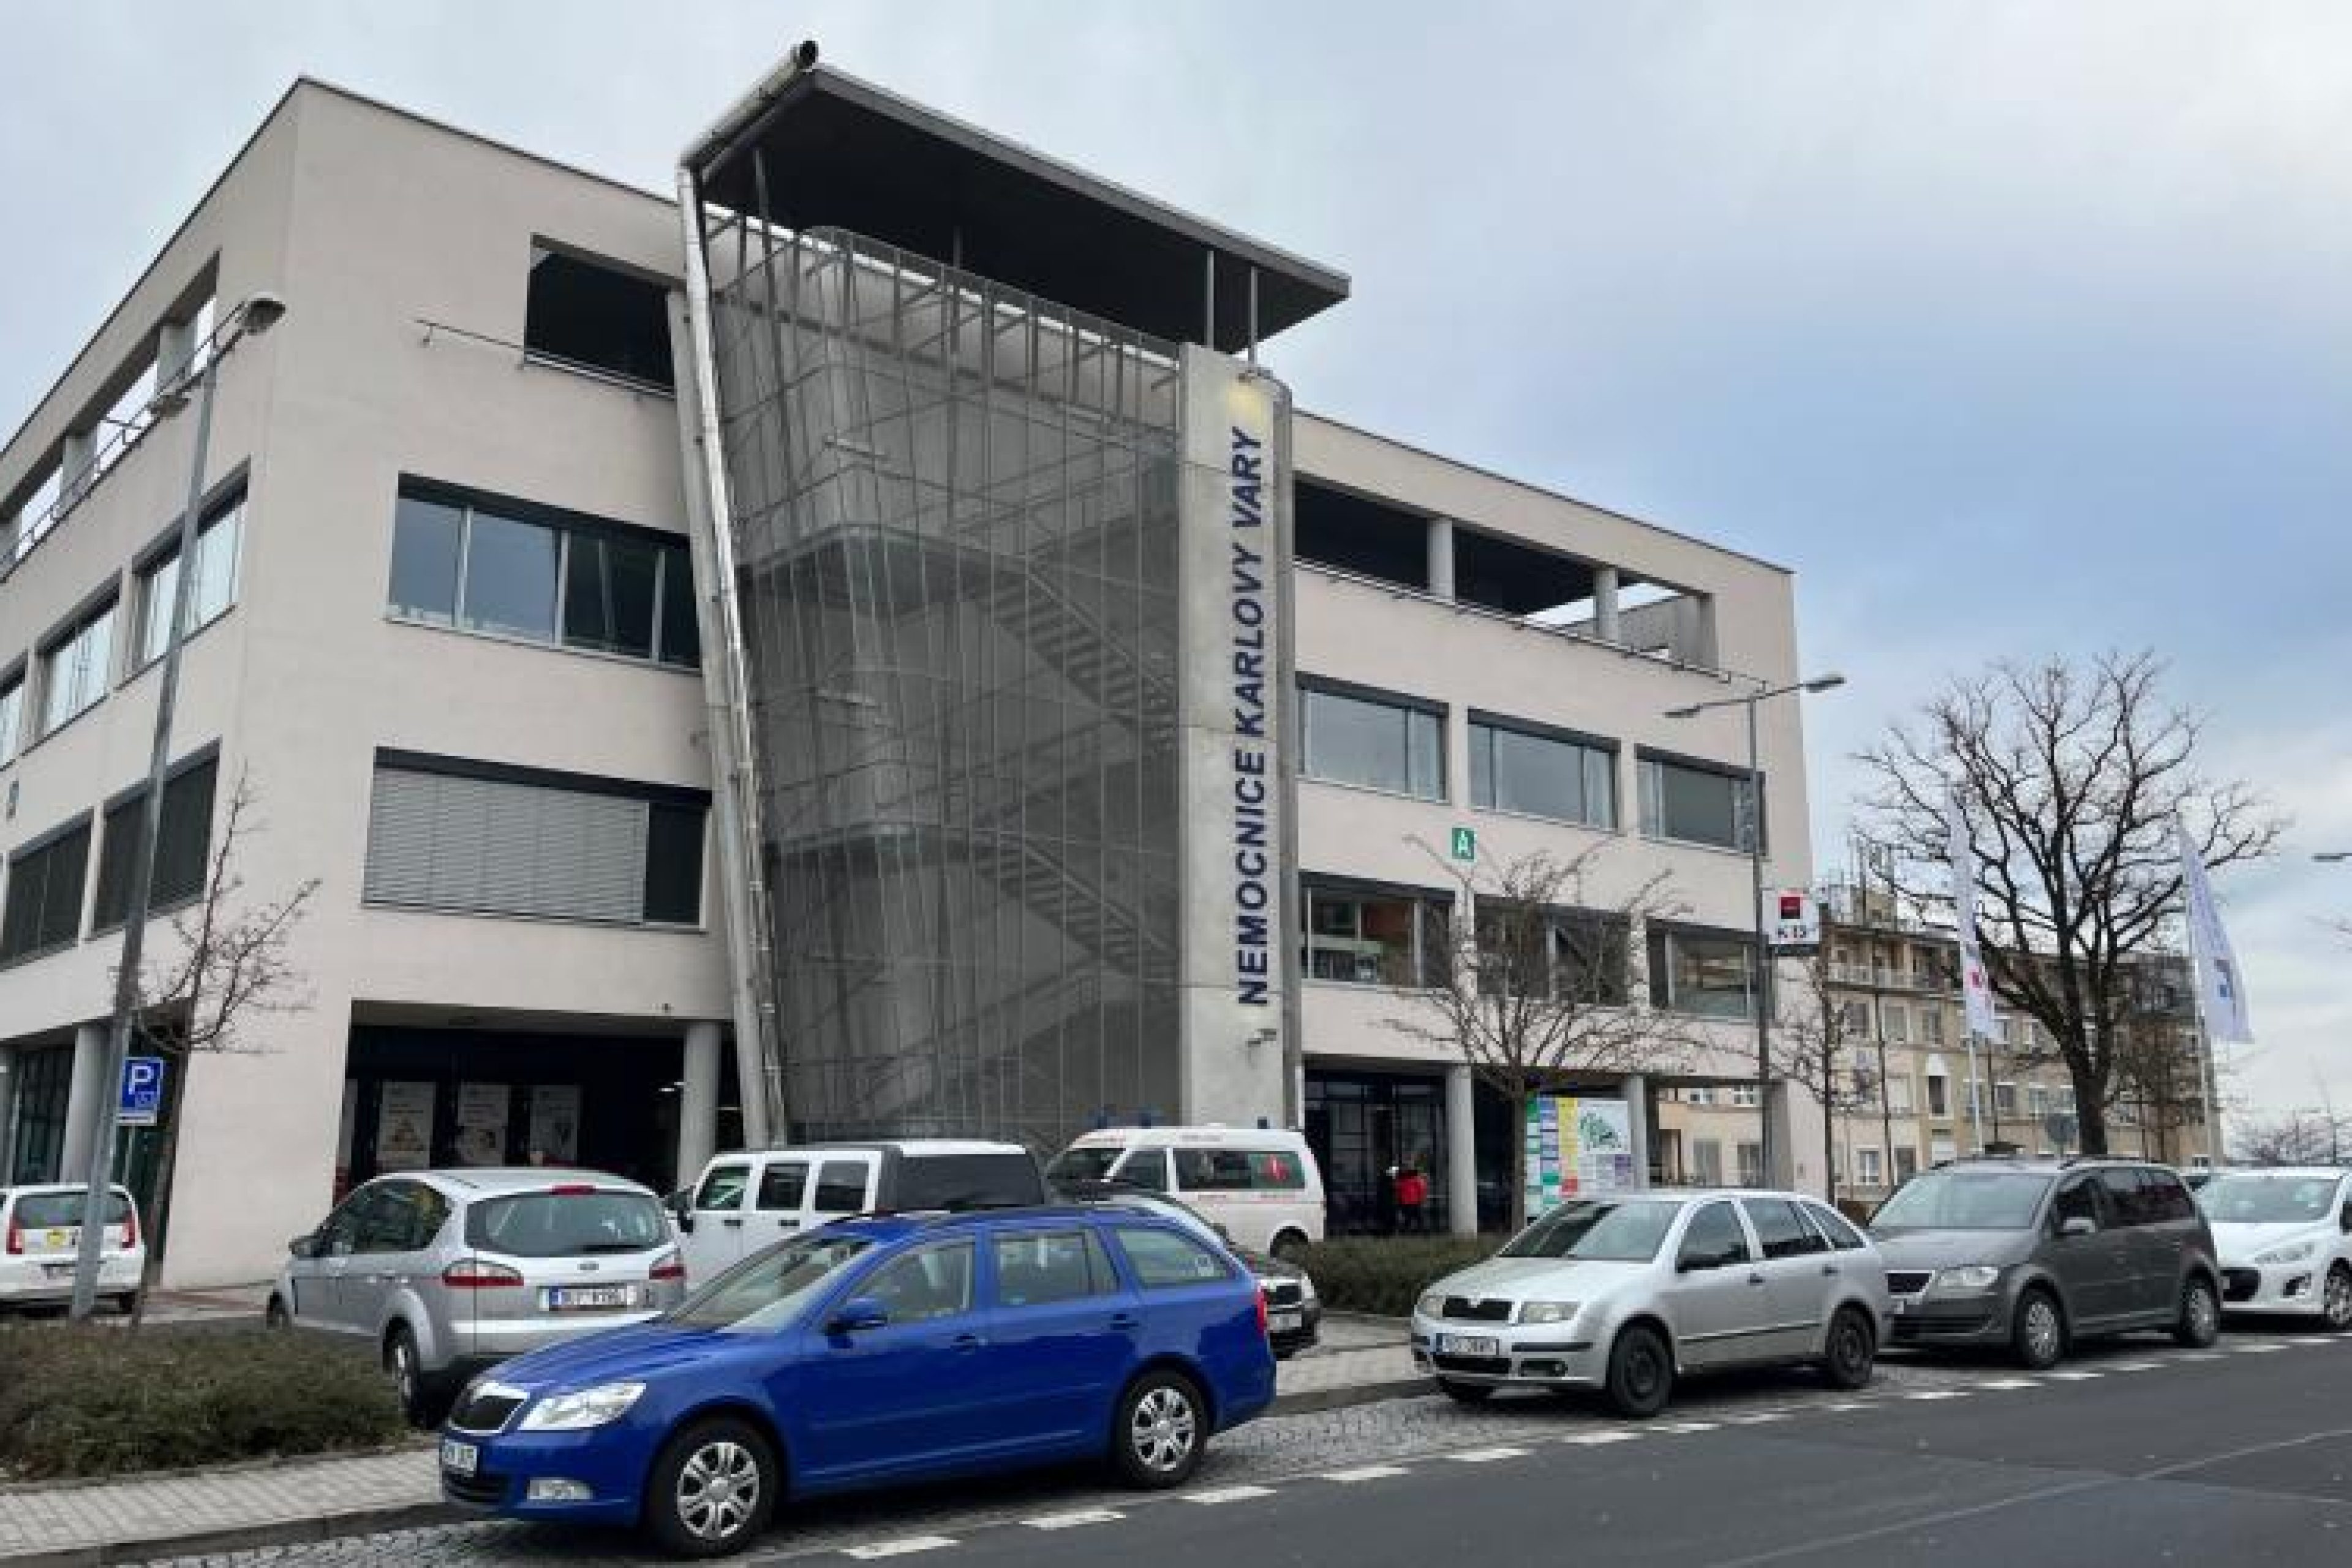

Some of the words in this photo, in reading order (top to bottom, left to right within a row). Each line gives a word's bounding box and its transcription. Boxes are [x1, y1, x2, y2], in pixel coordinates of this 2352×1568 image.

[1232, 426, 1262, 528] VARY
[1233, 541, 1264, 737] KARLOVY
[1235, 748, 1267, 1005] NEMOCNICE
[1458, 831, 1471, 856] A
[129, 1063, 154, 1095] P
